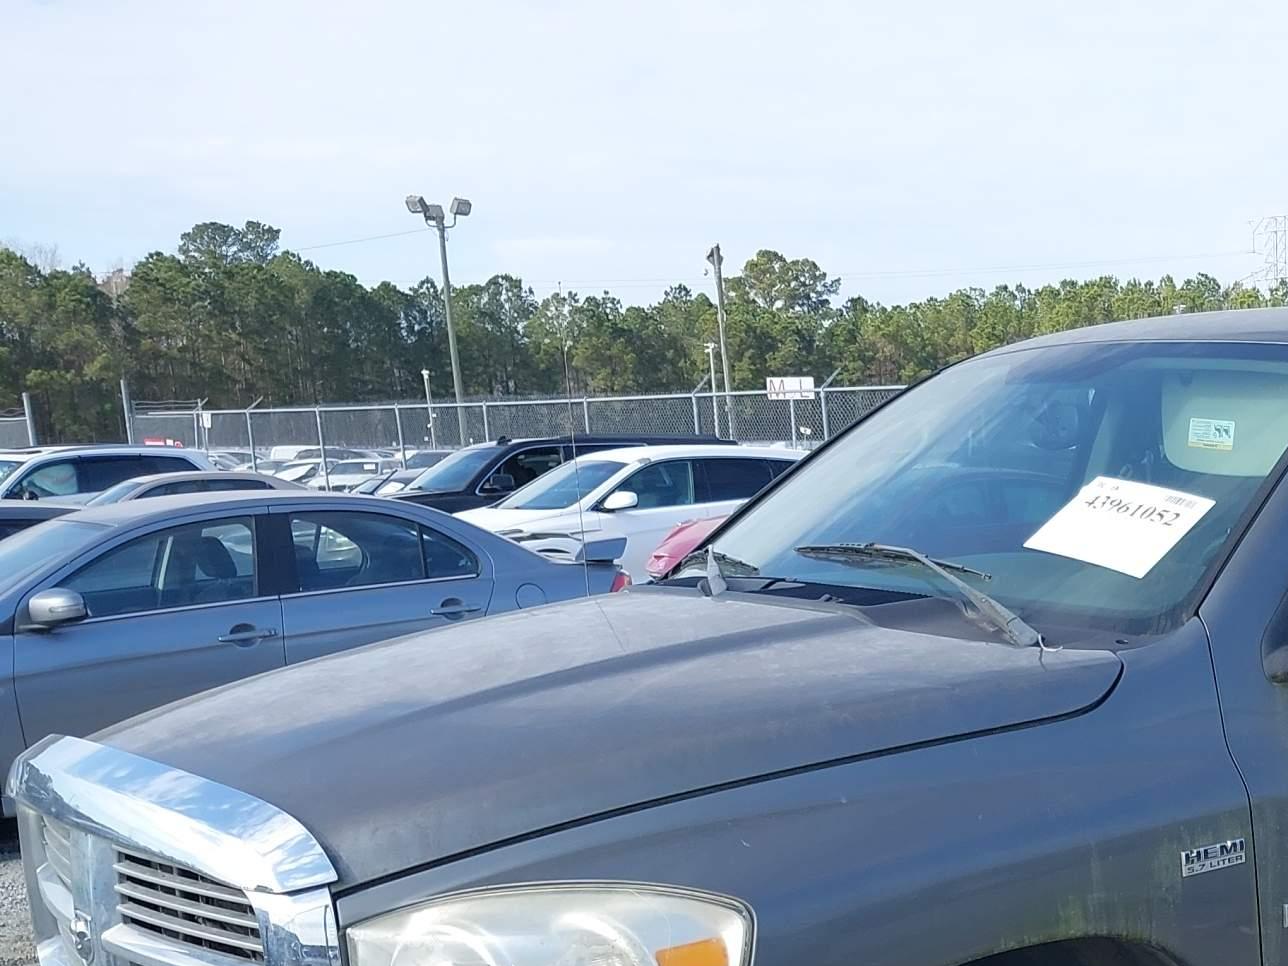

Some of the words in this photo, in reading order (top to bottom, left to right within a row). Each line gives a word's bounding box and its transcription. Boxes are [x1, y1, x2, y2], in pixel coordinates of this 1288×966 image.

[1085, 495, 1181, 527] 43961052
[1184, 838, 1245, 865] HEMI
[1186, 862, 1206, 874] 5.7
[1209, 854, 1244, 869] LITER
